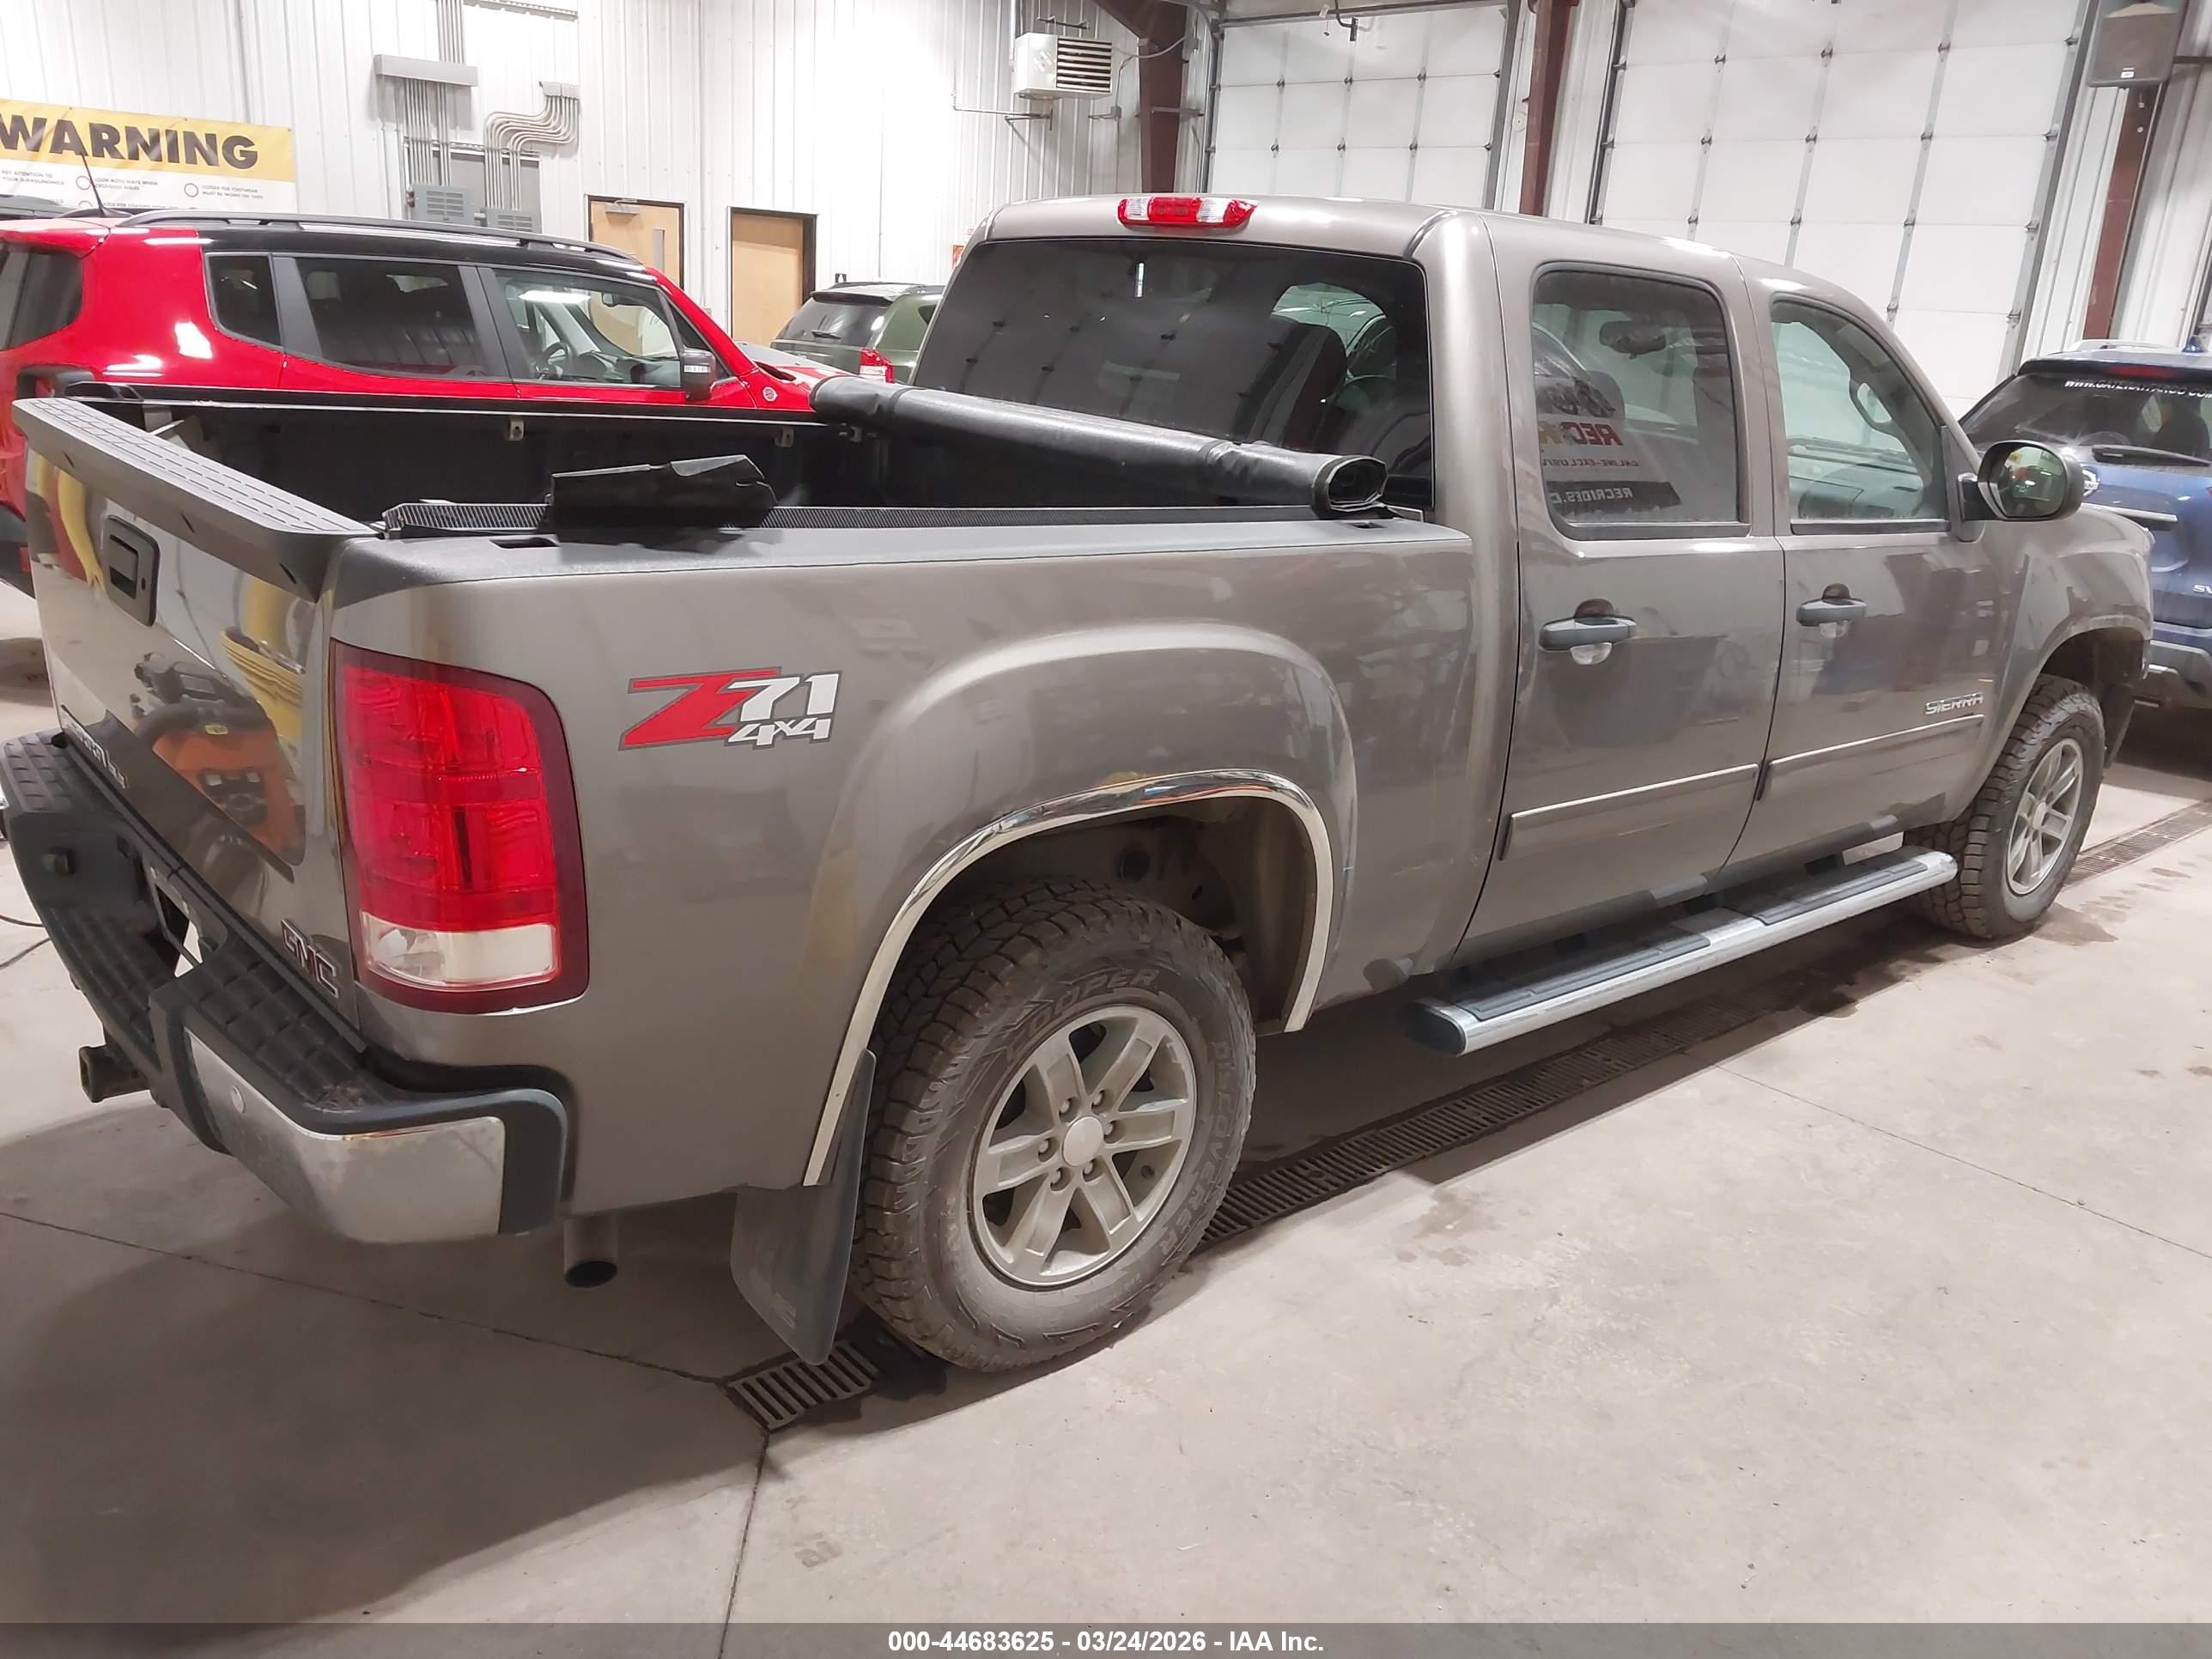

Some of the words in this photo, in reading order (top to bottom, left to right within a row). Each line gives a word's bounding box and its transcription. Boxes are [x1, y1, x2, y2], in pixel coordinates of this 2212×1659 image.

[0, 112, 258, 170] WARNING
[622, 668, 841, 747] Z71
[1925, 692, 1984, 714] SIERRA
